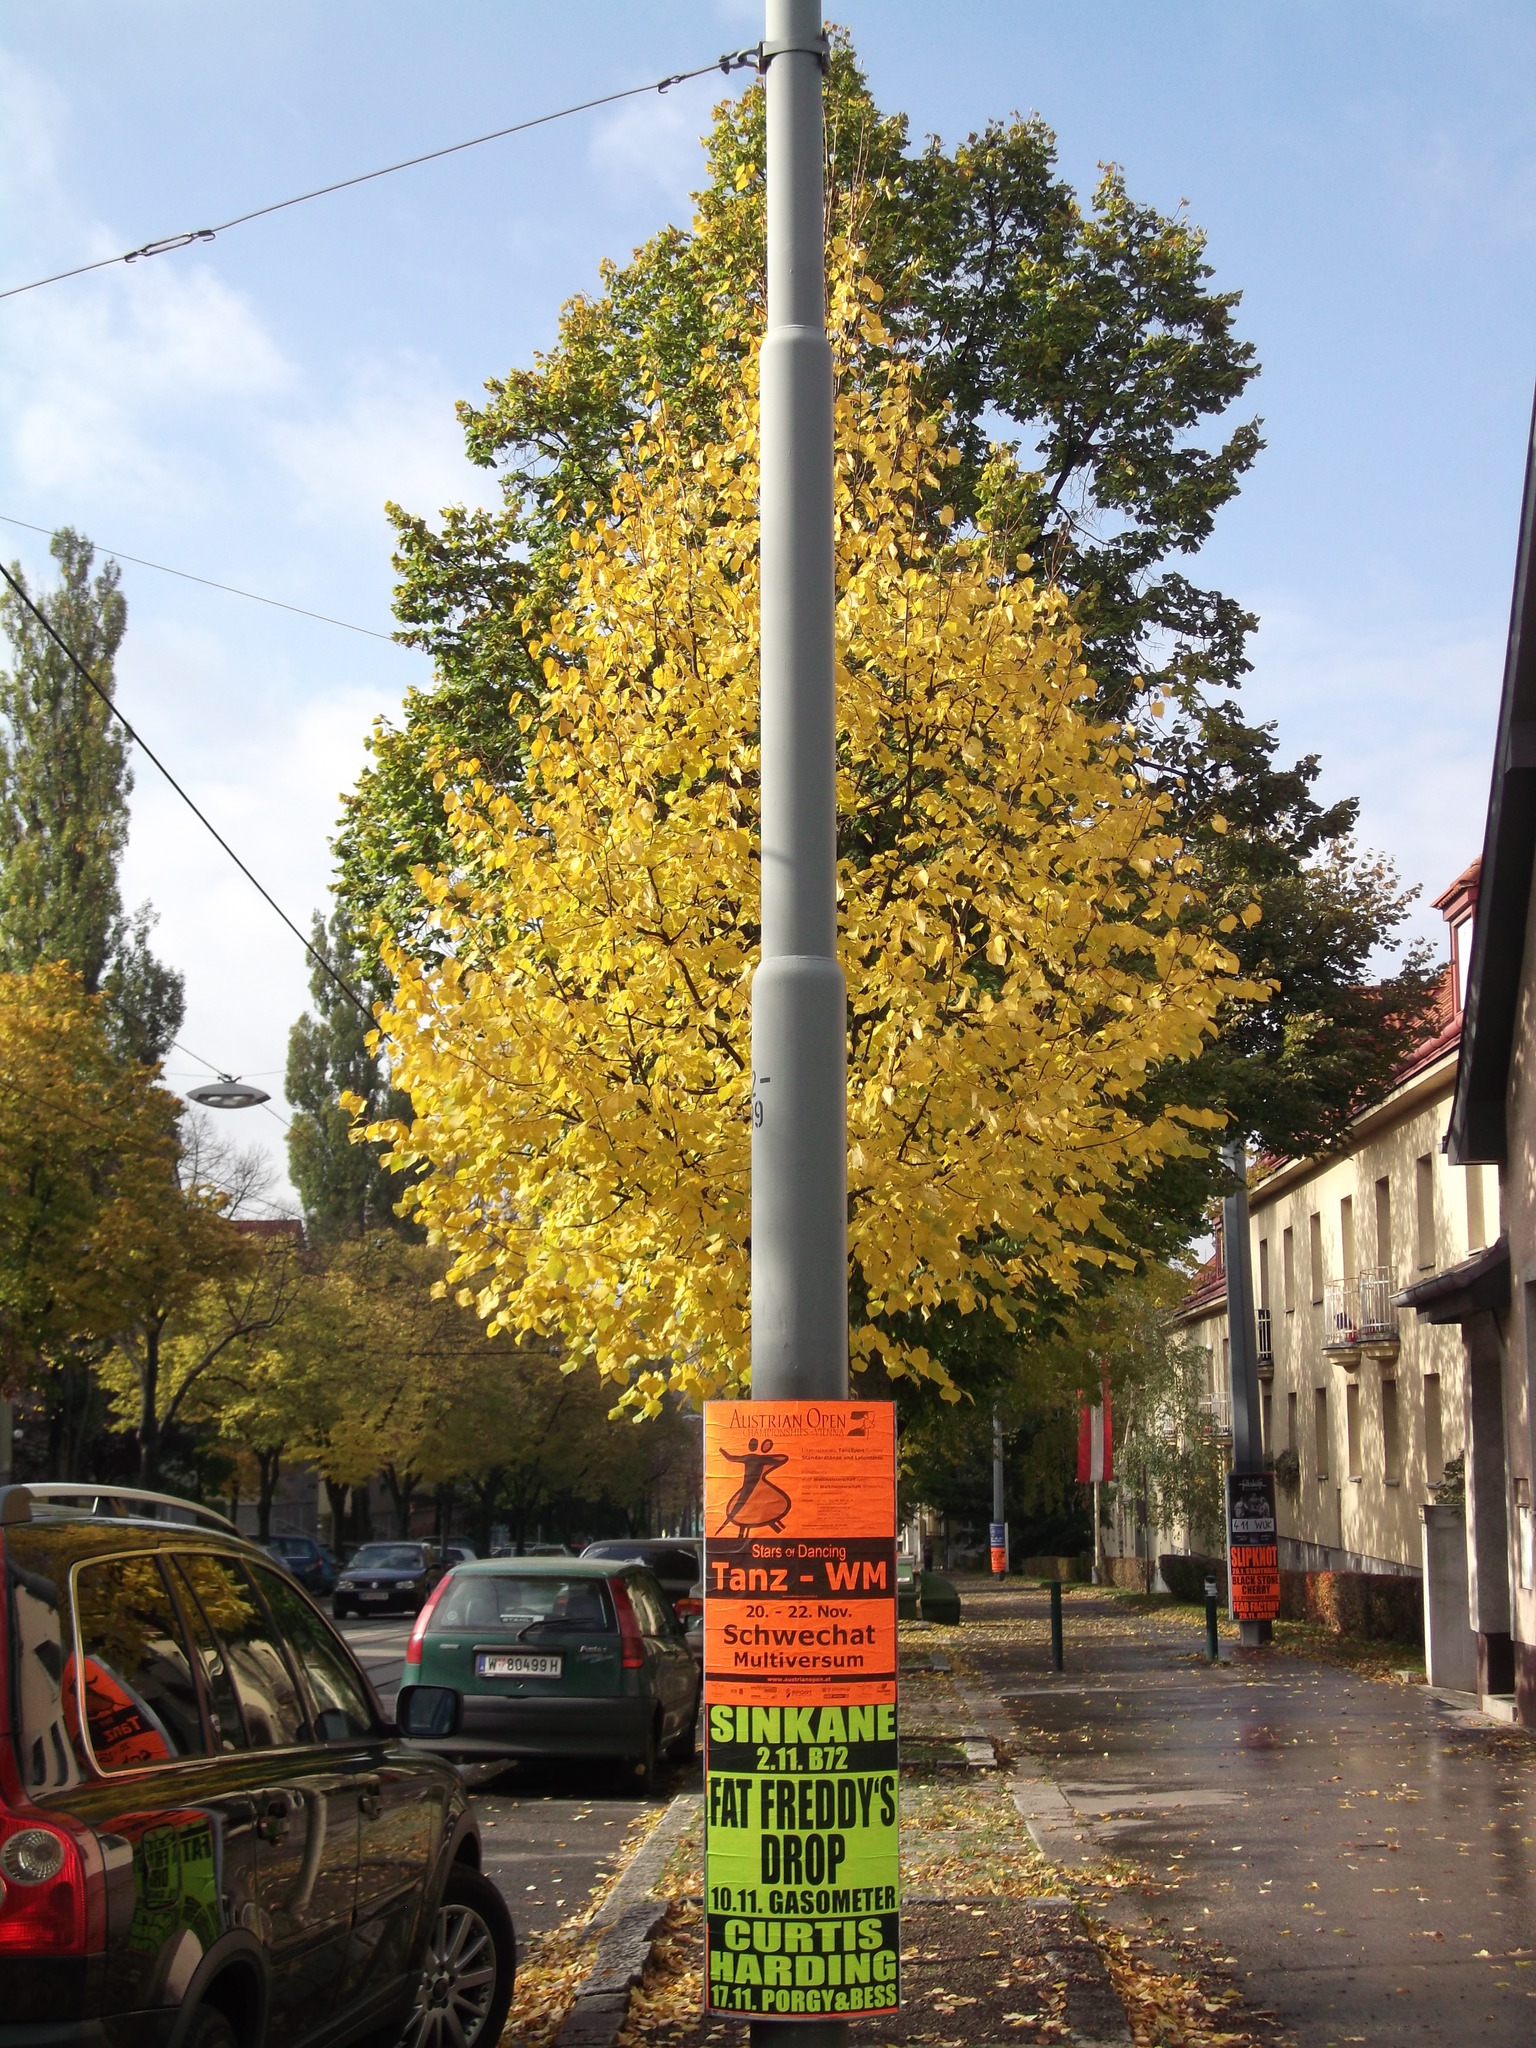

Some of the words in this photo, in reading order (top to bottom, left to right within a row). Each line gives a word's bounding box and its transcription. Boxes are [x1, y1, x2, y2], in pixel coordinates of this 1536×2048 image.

[806, 1407, 846, 1429] OPEN
[1254, 1520, 1272, 1530] WUK
[752, 1544, 782, 1558] Stars
[798, 1544, 847, 1561] Dancing
[1230, 1546, 1277, 1568] SLIPKNOT
[711, 1562, 788, 1592] Tanz
[825, 1561, 887, 1591] WM
[1232, 1576, 1256, 1585] BLACK
[1257, 1575, 1279, 1585] STONE
[1241, 1585, 1271, 1594] CHERRY
[746, 1605, 769, 1618] 20.
[788, 1605, 812, 1618] 22.
[817, 1605, 852, 1618] Nov.
[1250, 1601, 1280, 1612] FACTORY
[723, 1624, 876, 1646] Schwechat
[734, 1652, 864, 1668] Multiversum
[710, 1704, 896, 1744] SINKANE
[756, 1746, 803, 1771] 2.11.
[808, 1746, 849, 1771] B72
[710, 1777, 752, 1828] FAT
[761, 1833, 846, 1885] DROP
[711, 1887, 763, 1913] 10.11.
[769, 1885, 896, 1914] GASOMETER
[724, 1918, 883, 1953] CURTIS
[710, 1949, 897, 1987] HARDING
[711, 1984, 757, 2011] 17.11.
[761, 1983, 897, 2013] PORGY&BESS
